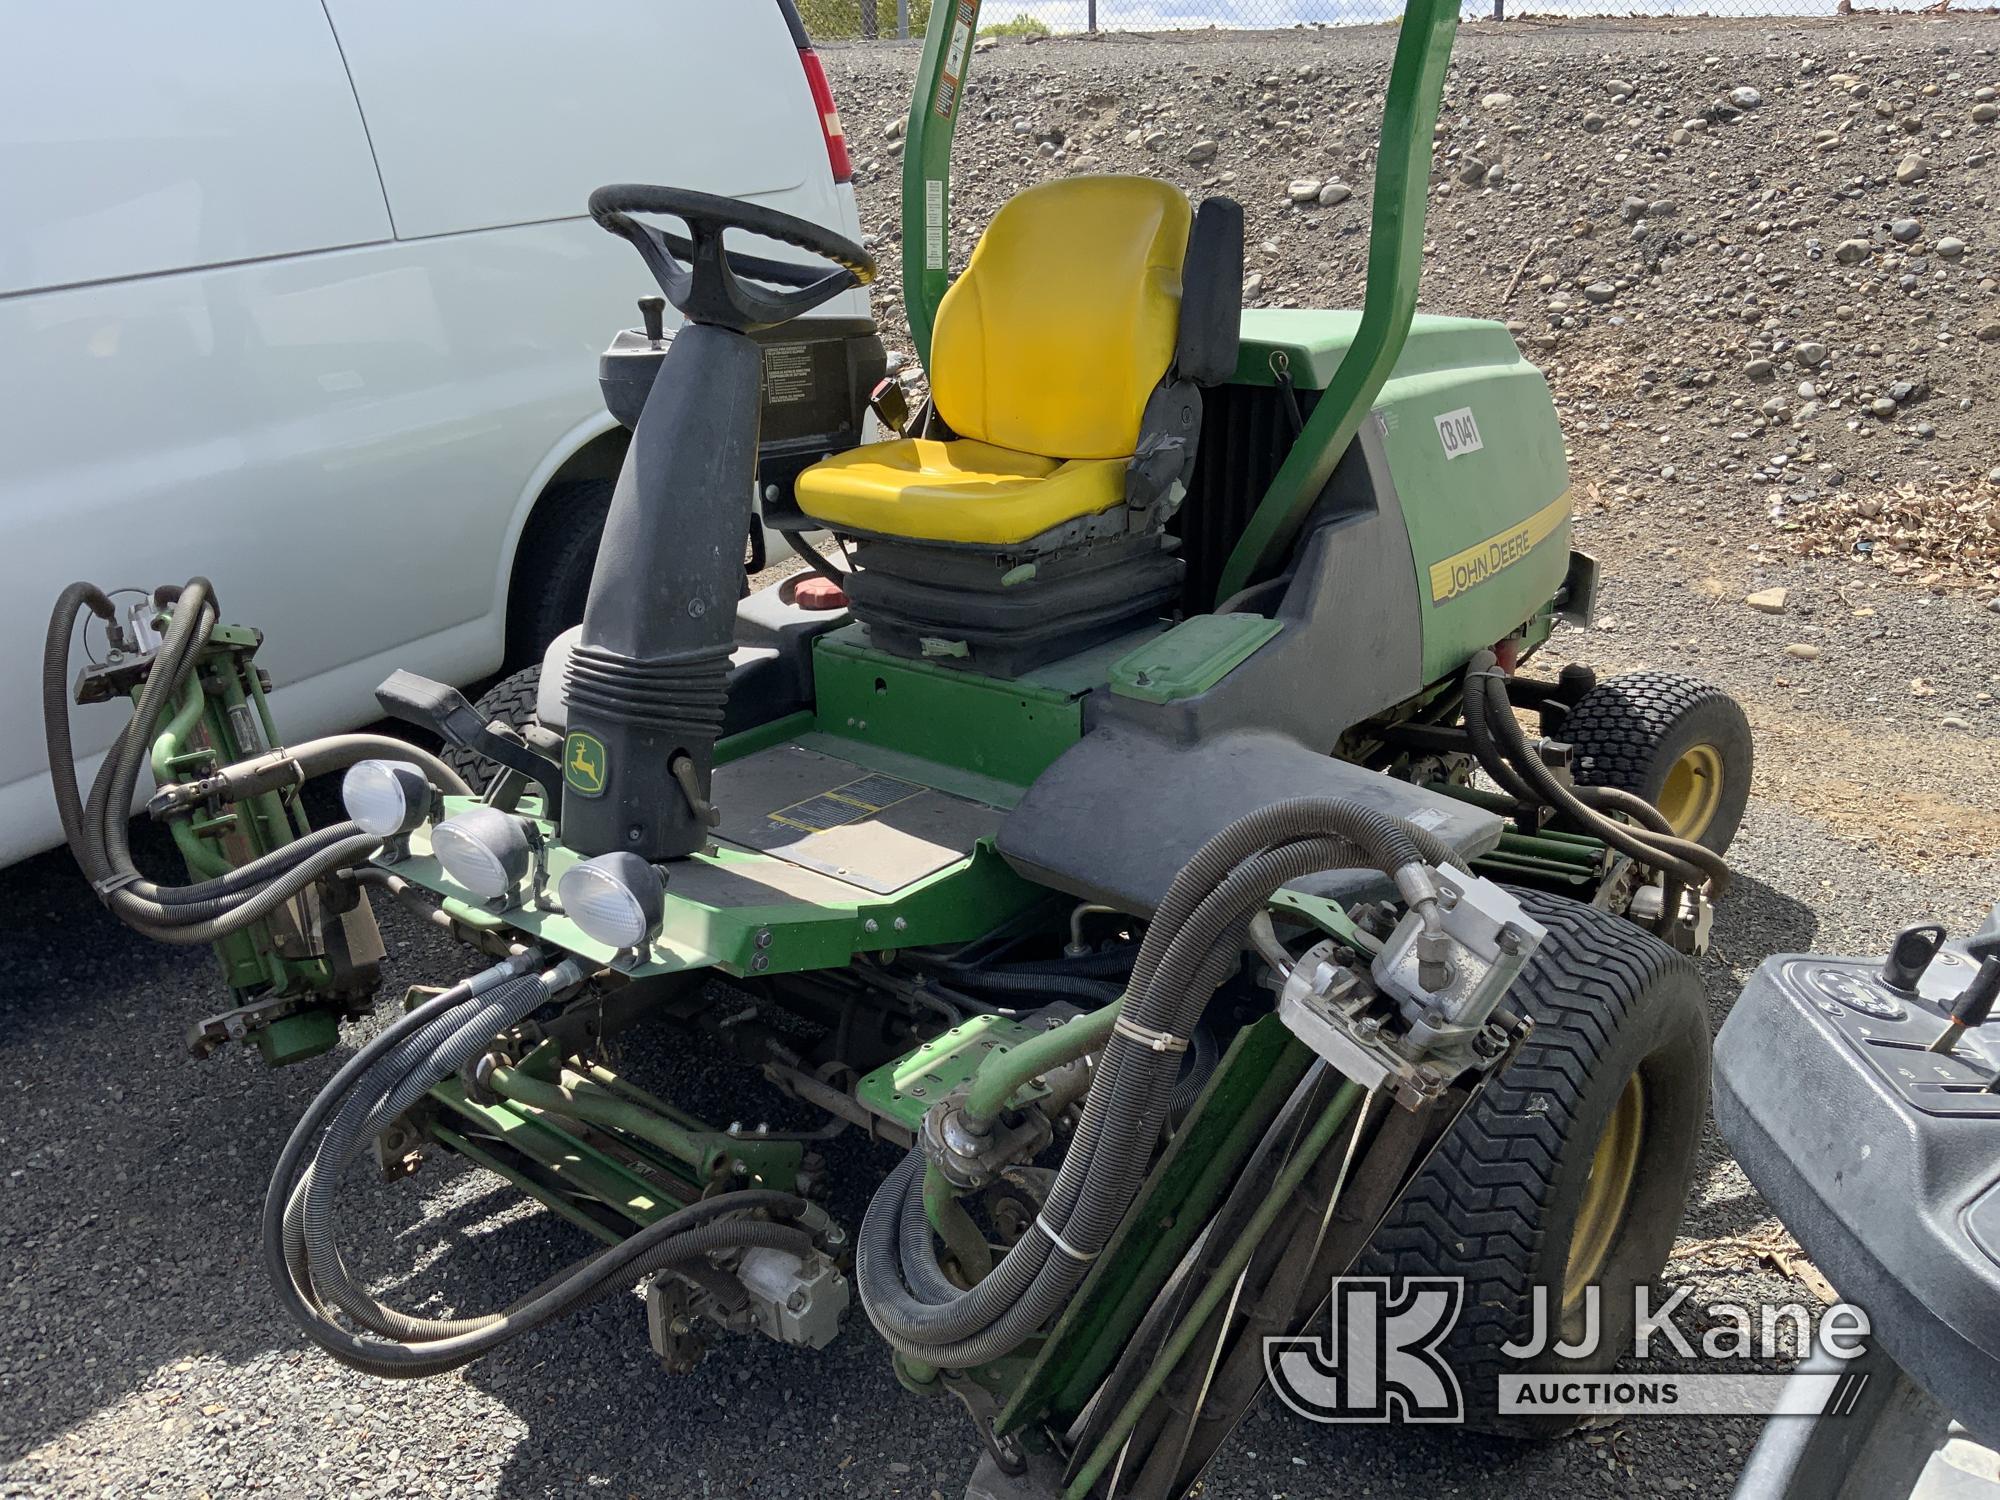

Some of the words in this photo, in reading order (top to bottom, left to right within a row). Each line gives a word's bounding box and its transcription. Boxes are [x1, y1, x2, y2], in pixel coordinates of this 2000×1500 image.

[1440, 420, 1458, 451] CB
[1455, 415, 1478, 447] 041
[1447, 554, 1489, 596] JOHN
[1489, 529, 1531, 571] DEERE
